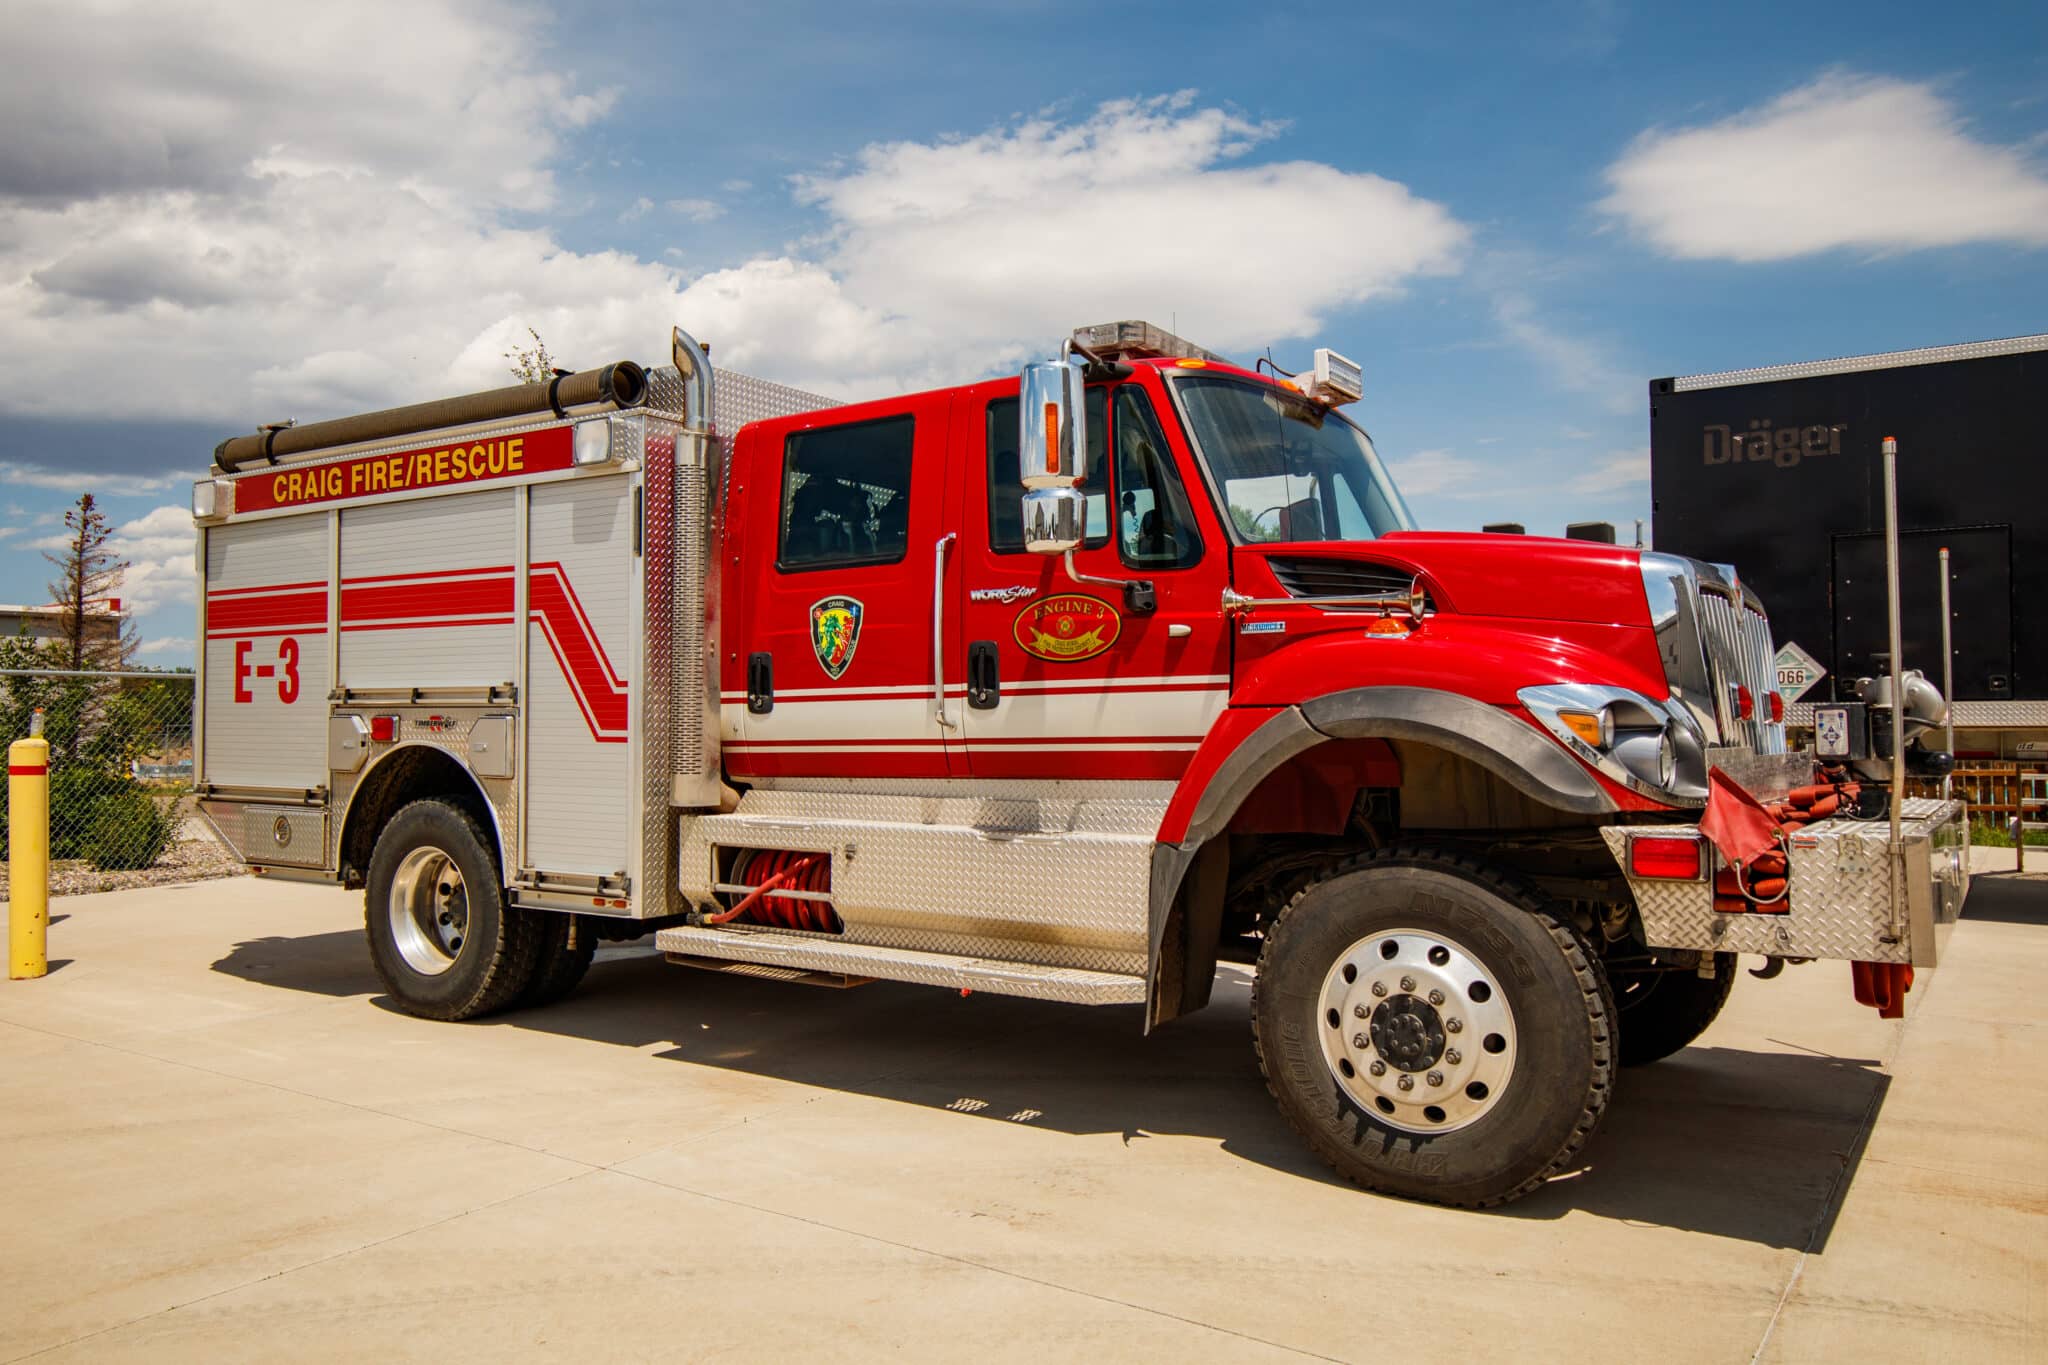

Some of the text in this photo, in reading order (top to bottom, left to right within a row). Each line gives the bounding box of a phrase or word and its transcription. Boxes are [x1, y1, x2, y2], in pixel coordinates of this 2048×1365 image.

[1703, 419, 1848, 468] Dräger
[273, 438, 524, 503] CRAIG FIRE/RESCUE
[1033, 599, 1105, 620] ENGINE 3
[234, 637, 300, 704] E-3
[1776, 670, 1805, 685] 066
